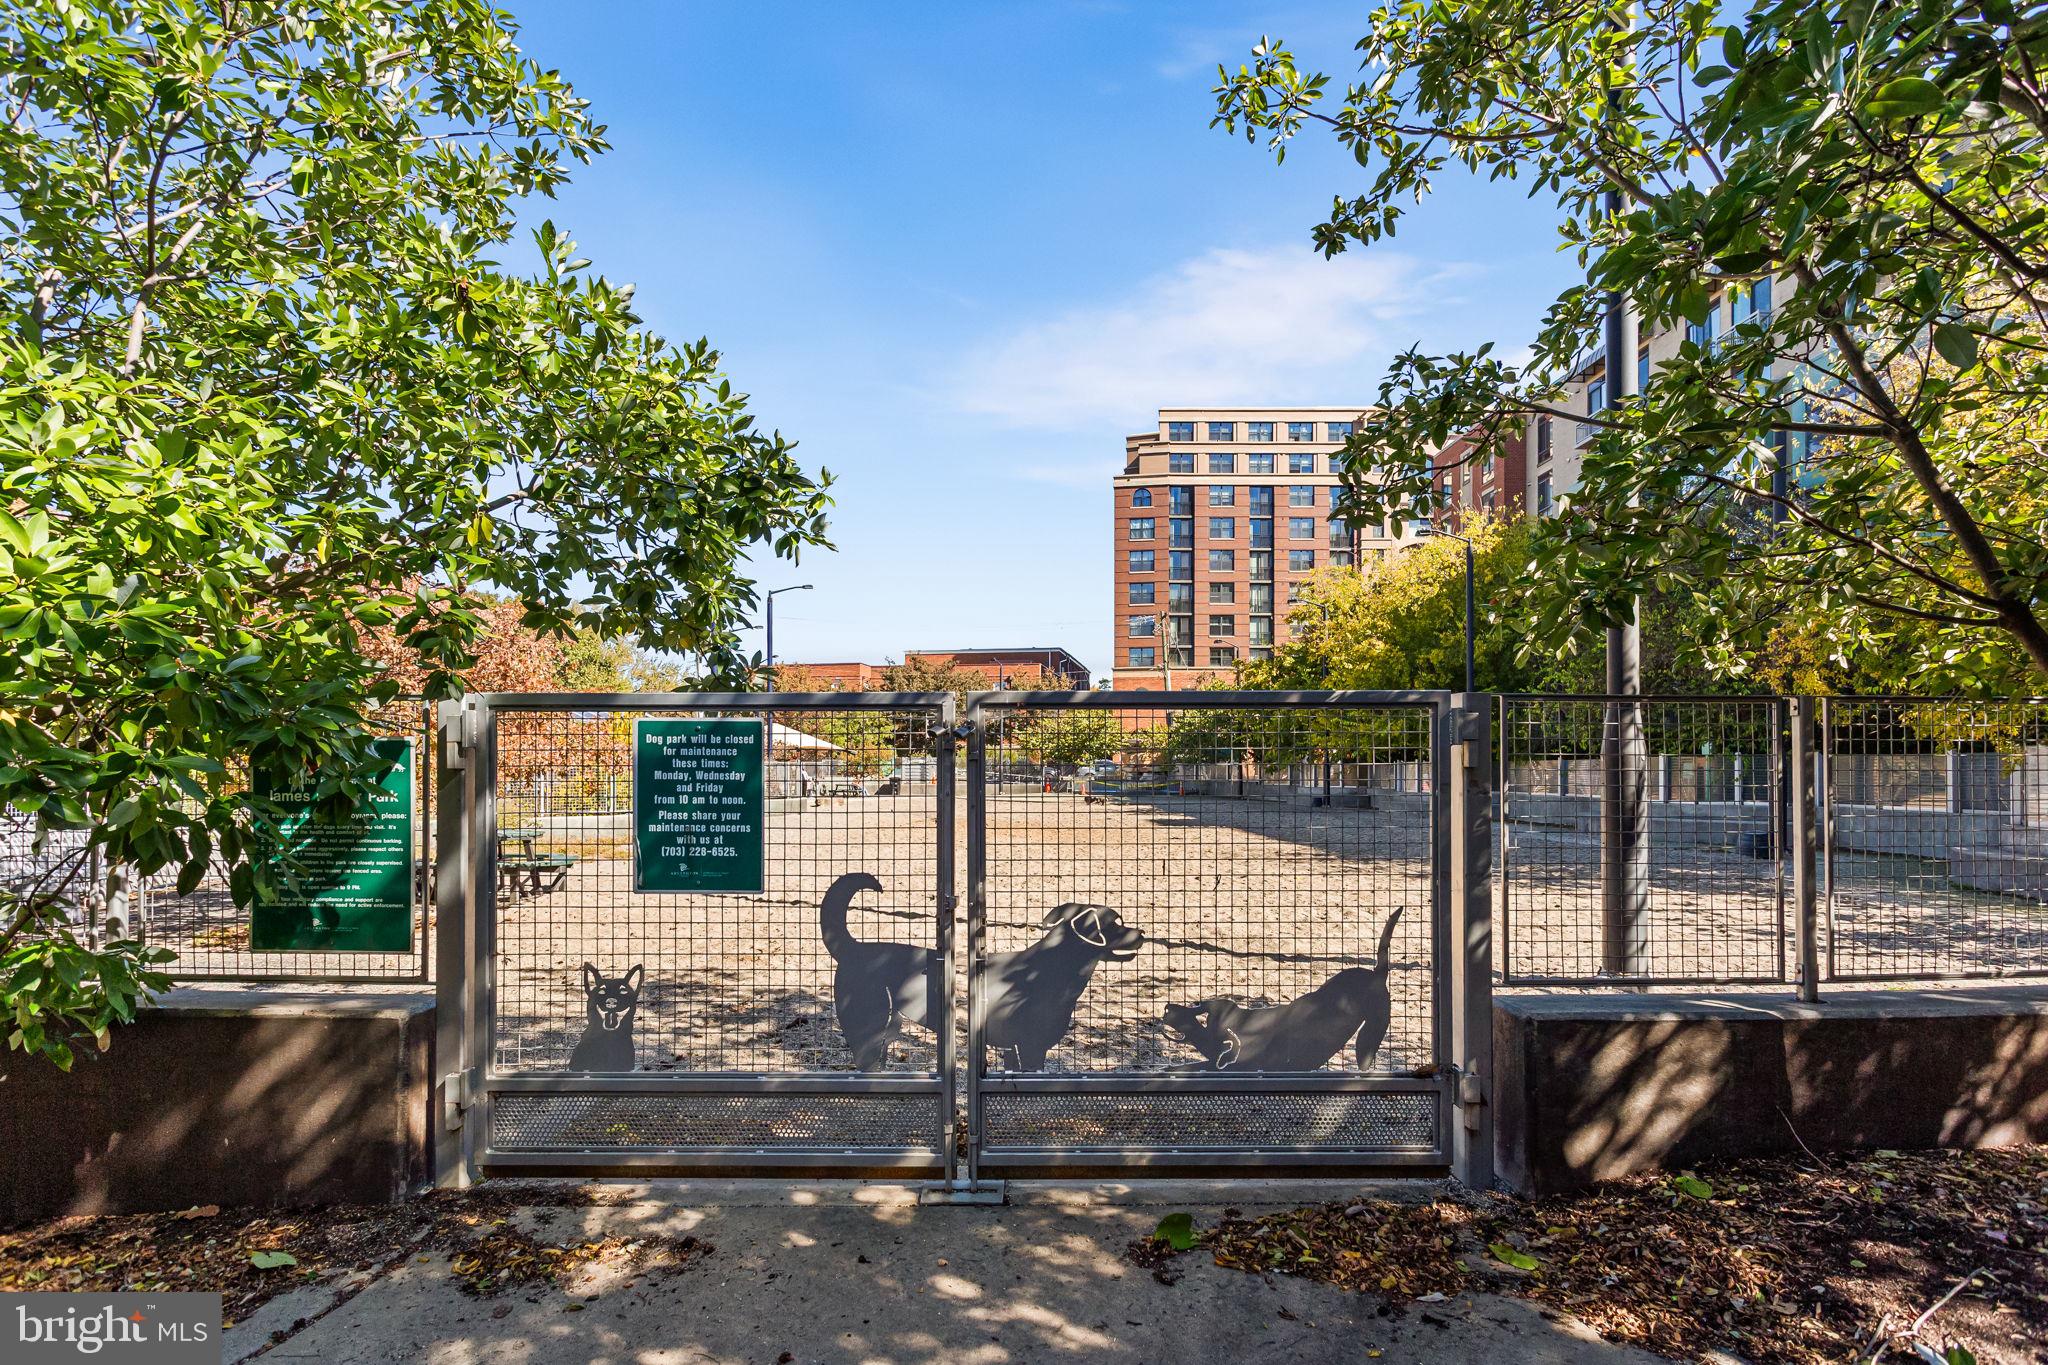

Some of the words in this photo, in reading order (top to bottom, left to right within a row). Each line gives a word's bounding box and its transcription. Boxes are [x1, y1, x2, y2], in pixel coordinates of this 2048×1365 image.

[646, 734, 663, 744] Dog
[666, 734, 687, 744] park
[691, 734, 707, 744] will
[710, 734, 721, 744] be
[725, 734, 754, 744] closed
[663, 746, 676, 756] for
[680, 746, 737, 756] maintenance
[672, 758, 697, 768] these
[701, 758, 729, 768] times:
[368, 776, 376, 784] at
[654, 771, 692, 781] Monday,
[696, 771, 746, 781] Wednesday
[676, 783, 692, 792] and
[696, 783, 724, 793] Friday
[654, 795, 675, 804] from
[679, 795, 688, 804] 10
[692, 796, 705, 804] am
[709, 795, 718, 804] to
[722, 796, 746, 804] noon.
[658, 810, 688, 820] Please
[692, 810, 717, 820] share
[721, 812, 741, 821] your
[648, 823, 706, 832] maintenance
[676, 835, 696, 844] with
[714, 835, 723, 844] at
[661, 847, 685, 857] (703)
[689, 847, 738, 857] 228-6525.
